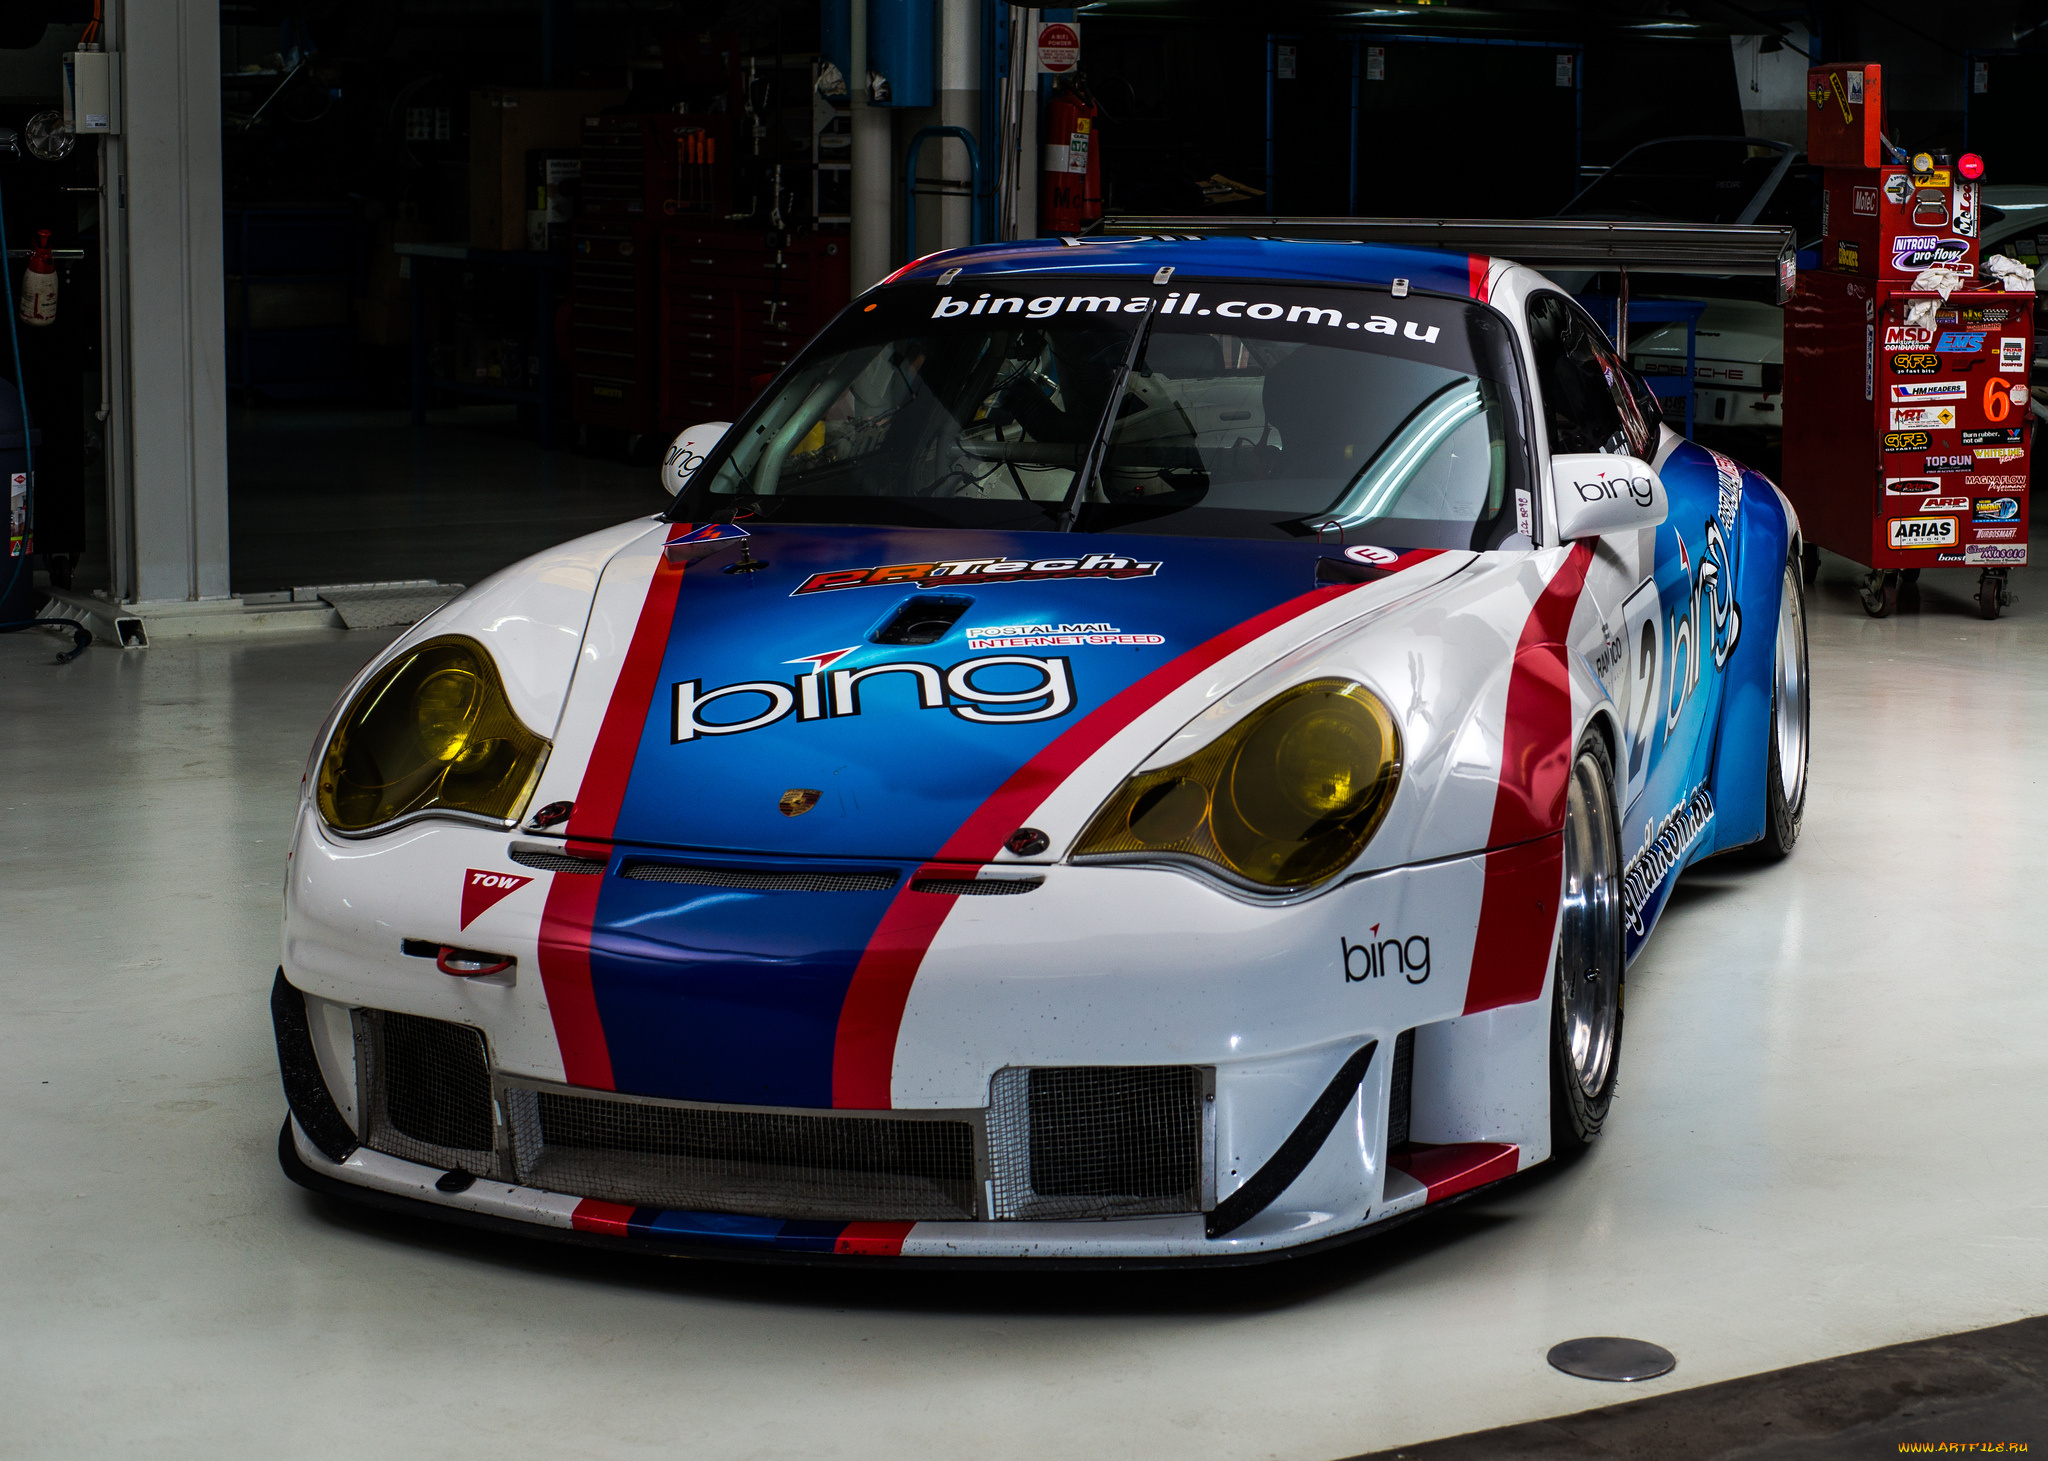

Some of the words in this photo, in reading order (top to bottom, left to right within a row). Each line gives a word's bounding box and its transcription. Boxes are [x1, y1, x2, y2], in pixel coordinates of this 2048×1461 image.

[1855, 191, 1876, 211] MoTeC
[1896, 238, 1936, 251] NITROUS
[931, 291, 1441, 345] bingmail.com.au
[1963, 309, 1983, 318] KING
[1887, 328, 1931, 343] MSD
[1939, 335, 1984, 350] EMS
[1894, 354, 1938, 369] GFB
[1912, 387, 1928, 395] HM
[1928, 385, 1961, 393] HEADERS
[1983, 377, 2011, 422] 6
[1895, 409, 1926, 421] MRT
[1884, 433, 1928, 447] GFB
[1974, 448, 2022, 458] WHITELINE
[1925, 456, 1948, 467] TOP
[1949, 455, 1972, 466] GUN
[1965, 475, 2027, 485] MAGNAFLOW
[1574, 472, 1653, 507] bing
[1925, 498, 1967, 507] ARP
[1895, 522, 1952, 538] ARIAS
[969, 625, 1058, 638] POSTAL
[1061, 623, 1118, 633] MAIL
[1662, 514, 1742, 752] bing
[971, 636, 1086, 649] INTERNET
[1088, 635, 1163, 645] SPEED
[671, 647, 1078, 745] bing
[1629, 618, 1658, 785] 2
[471, 873, 520, 889] TOW
[1341, 923, 1431, 985] bing
